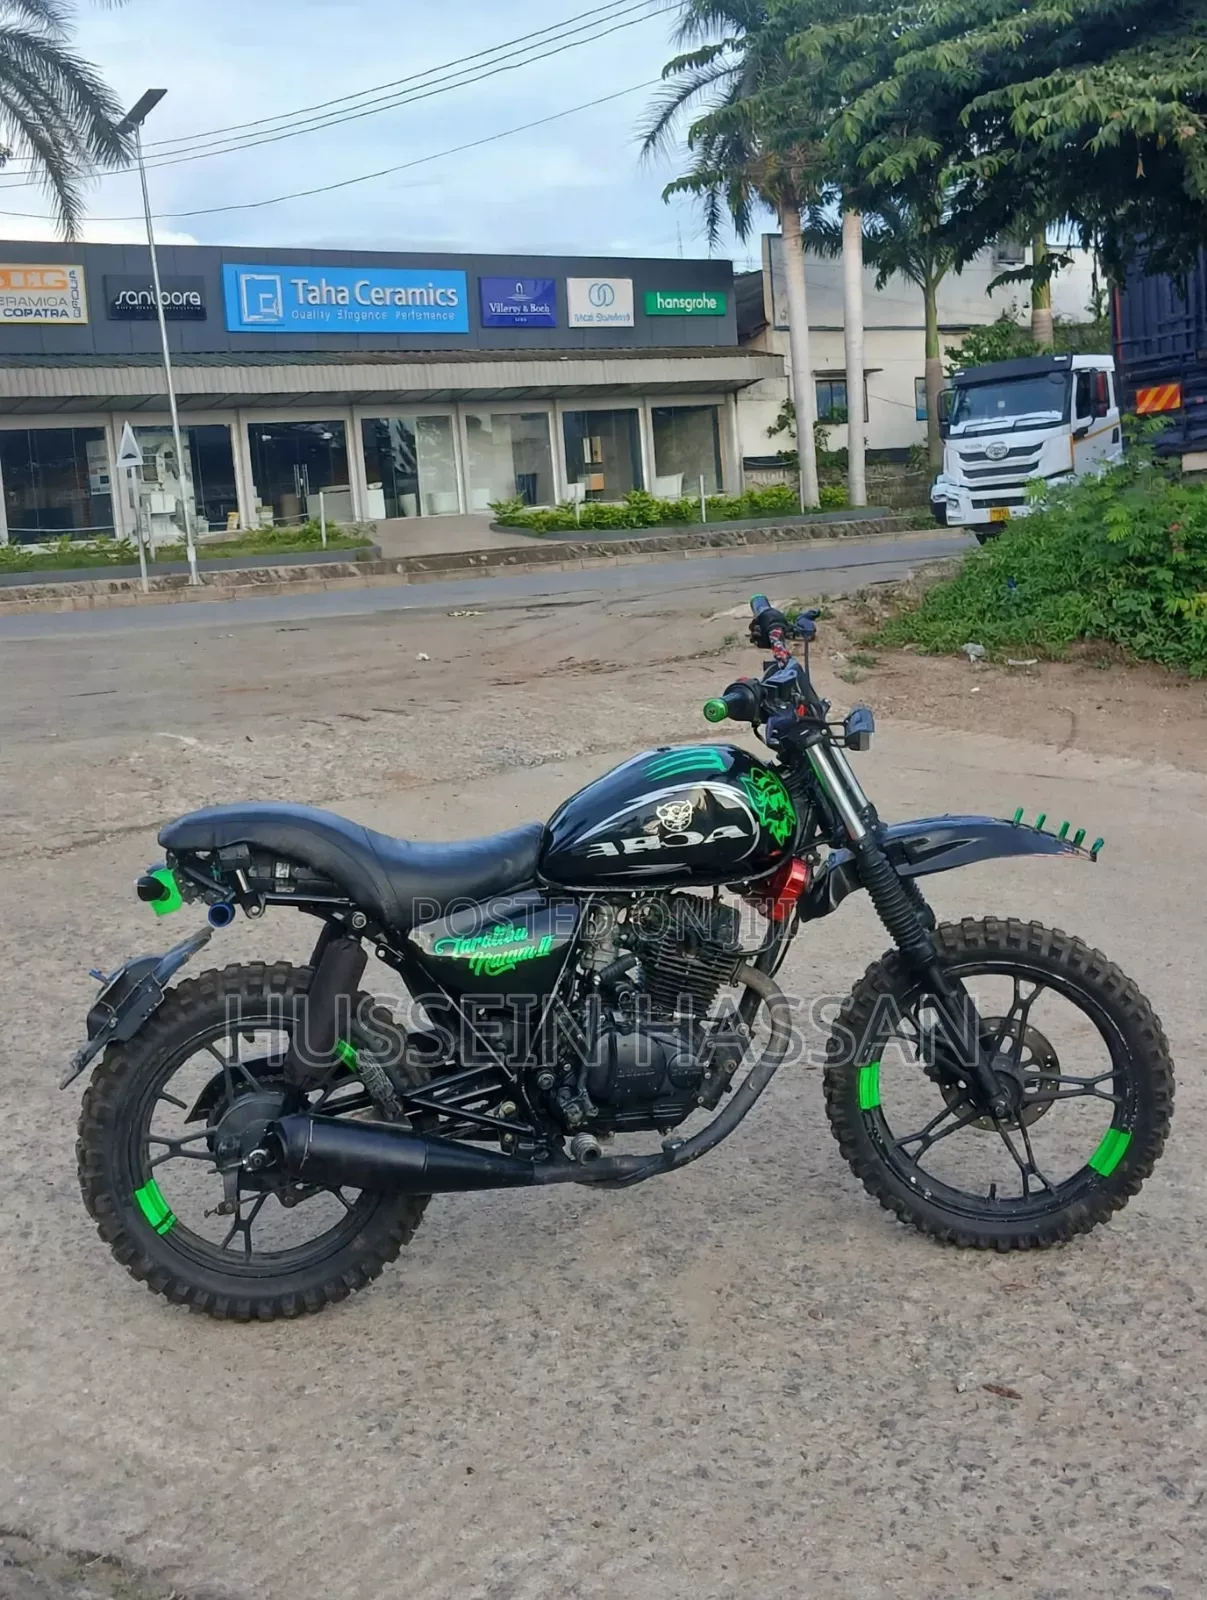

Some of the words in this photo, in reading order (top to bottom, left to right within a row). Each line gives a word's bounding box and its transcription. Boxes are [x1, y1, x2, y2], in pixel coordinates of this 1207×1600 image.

[290, 278, 350, 305] Taha
[354, 280, 459, 307] Ceramics
[489, 302, 521, 316] Villeroy
[530, 303, 550, 313] Boch
[656, 292, 718, 312] hansgrohe
[291, 309, 331, 321] Quality
